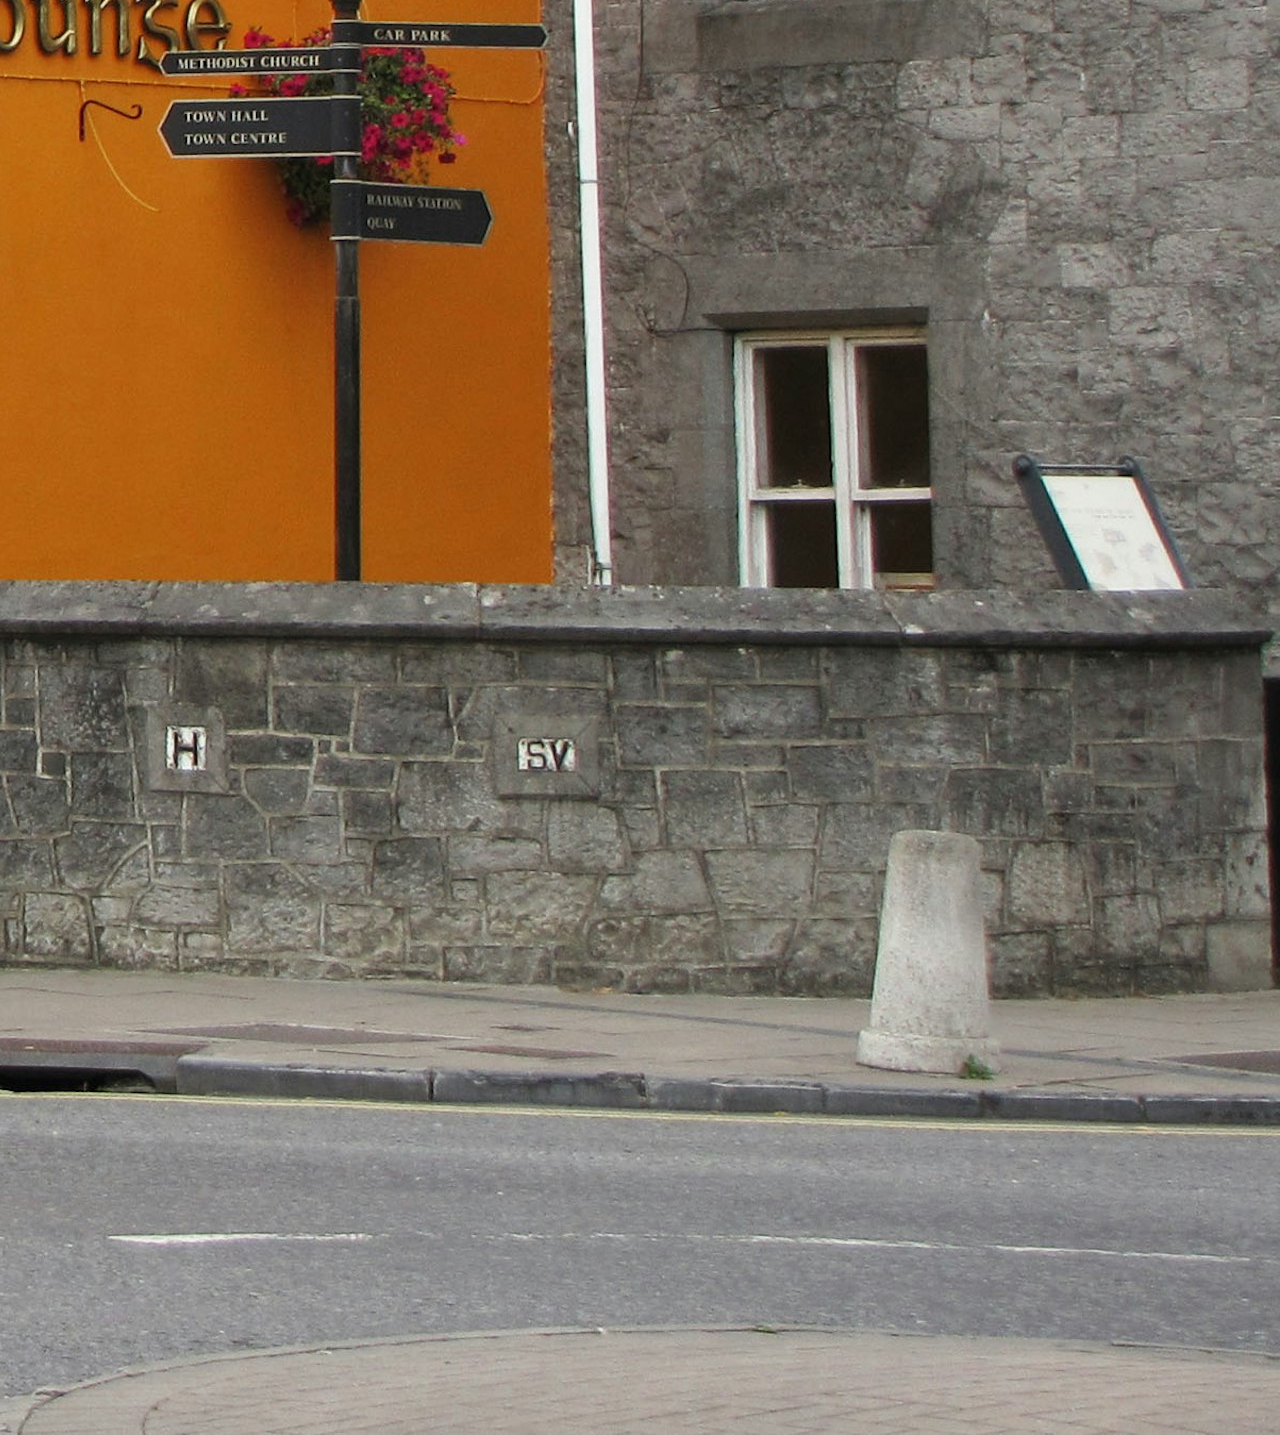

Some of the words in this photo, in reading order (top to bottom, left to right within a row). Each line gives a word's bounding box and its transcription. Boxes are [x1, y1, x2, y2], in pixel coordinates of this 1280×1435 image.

[373, 28, 407, 42] CAR
[411, 28, 451, 43] PARK
[177, 56, 256, 70] METHODIST
[260, 54, 320, 69] CHURCH
[183, 110, 227, 123] TOWN
[230, 109, 269, 122] HALL
[183, 132, 227, 146] TOWN
[230, 131, 288, 146] CENTRE
[366, 193, 413, 208] RAILWAY
[416, 196, 463, 210] STATION
[366, 216, 396, 230] QUAY
[171, 729, 199, 771] H
[526, 740, 572, 771] SV
